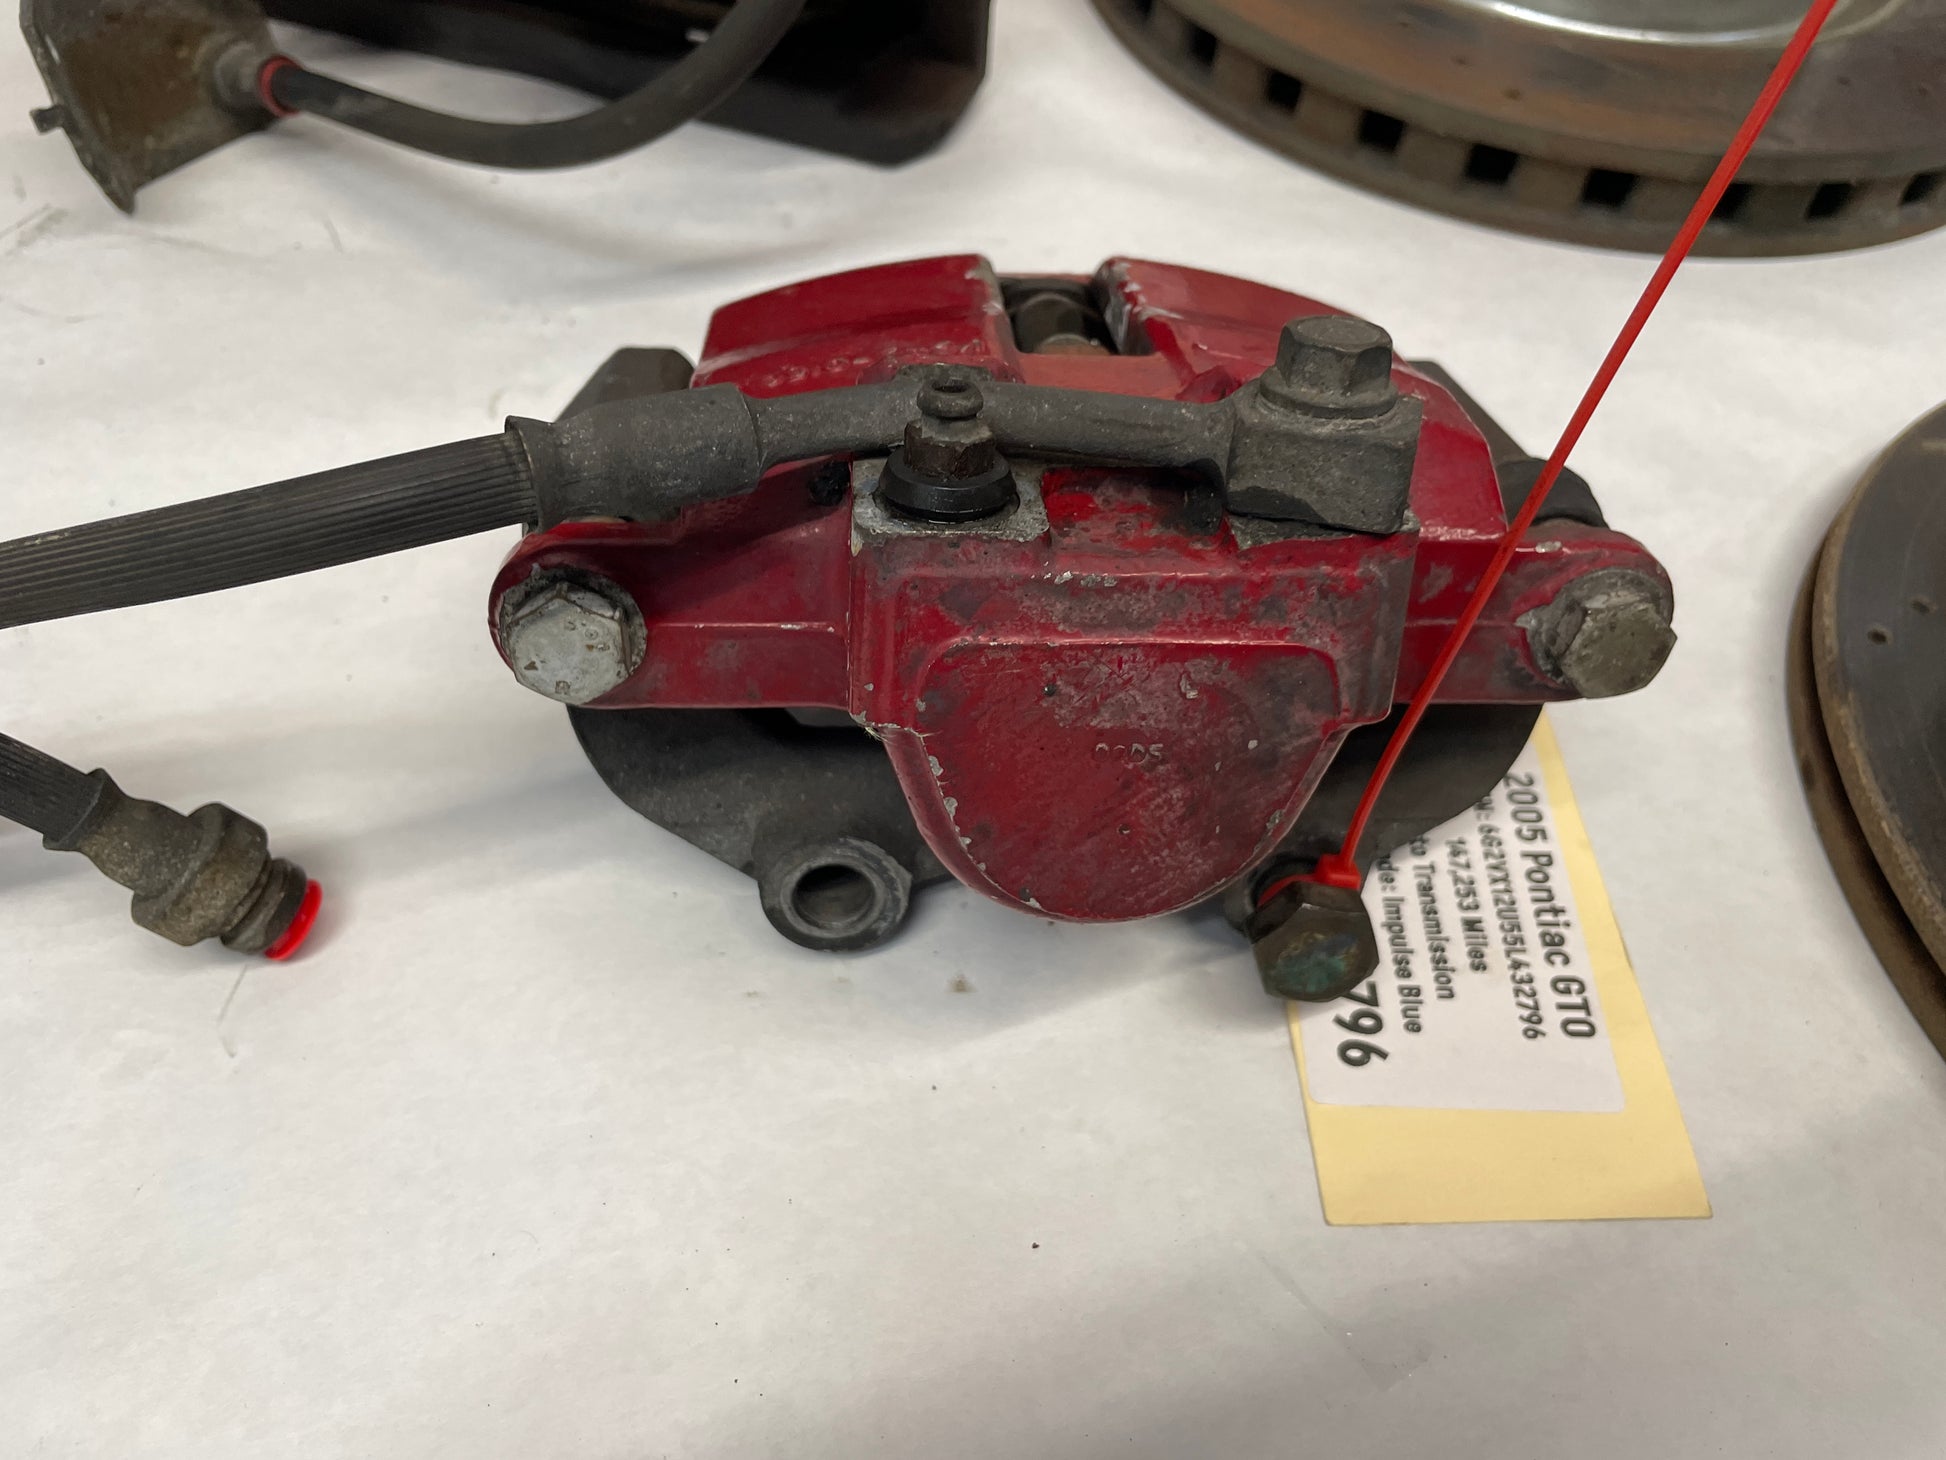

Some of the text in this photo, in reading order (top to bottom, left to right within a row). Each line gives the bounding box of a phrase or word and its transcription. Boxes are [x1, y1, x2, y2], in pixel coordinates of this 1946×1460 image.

[1380, 896, 1415, 979] Impulse
[1413, 861, 1456, 999] Transmission
[1461, 916, 1489, 972] Miles
[1503, 772, 1597, 1038] 2005 Pontiac GTO
[1332, 980, 1390, 1067] 796
[1397, 984, 1424, 1033] Blue
